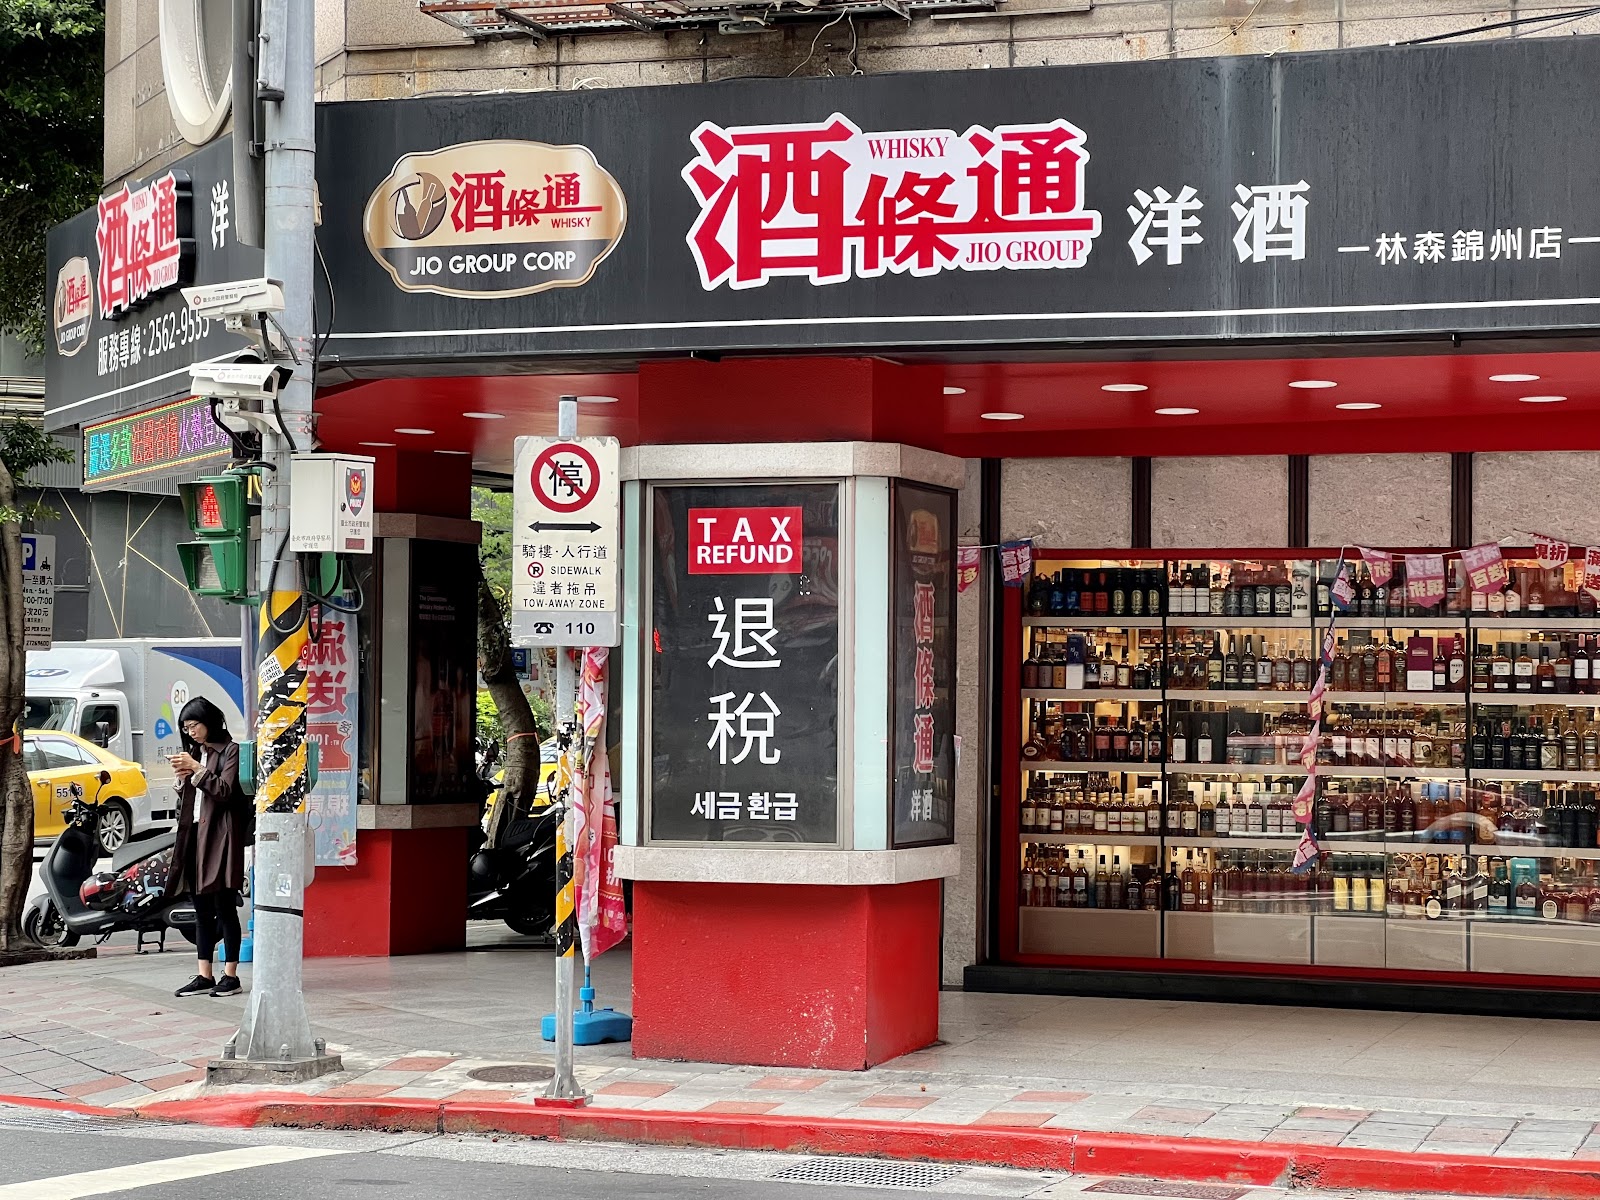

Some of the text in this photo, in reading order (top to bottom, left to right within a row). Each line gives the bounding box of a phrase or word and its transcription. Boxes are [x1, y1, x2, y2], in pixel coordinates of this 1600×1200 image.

[867, 136, 950, 160] WHISKY
[449, 169, 603, 233] 酒條通
[689, 119, 1094, 283] 酒條通
[210, 179, 230, 250] 洋
[551, 216, 592, 229] WHISKY
[97, 174, 180, 316] 酒條通
[966, 239, 1084, 264] JIO GROUP
[160, 260, 178, 283] GROUP
[410, 250, 577, 276] JIO GROUP CORP
[548, 460, 584, 497] 停
[697, 545, 793, 564] REFUND
[22, 574, 53, 586] 一至週六
[550, 566, 602, 576] SIDEWALK
[523, 598, 605, 609] TOW-AWAY ZONE
[565, 622, 595, 635] 110
[706, 595, 782, 766] 退稅
[690, 791, 799, 821] 세금 환급
